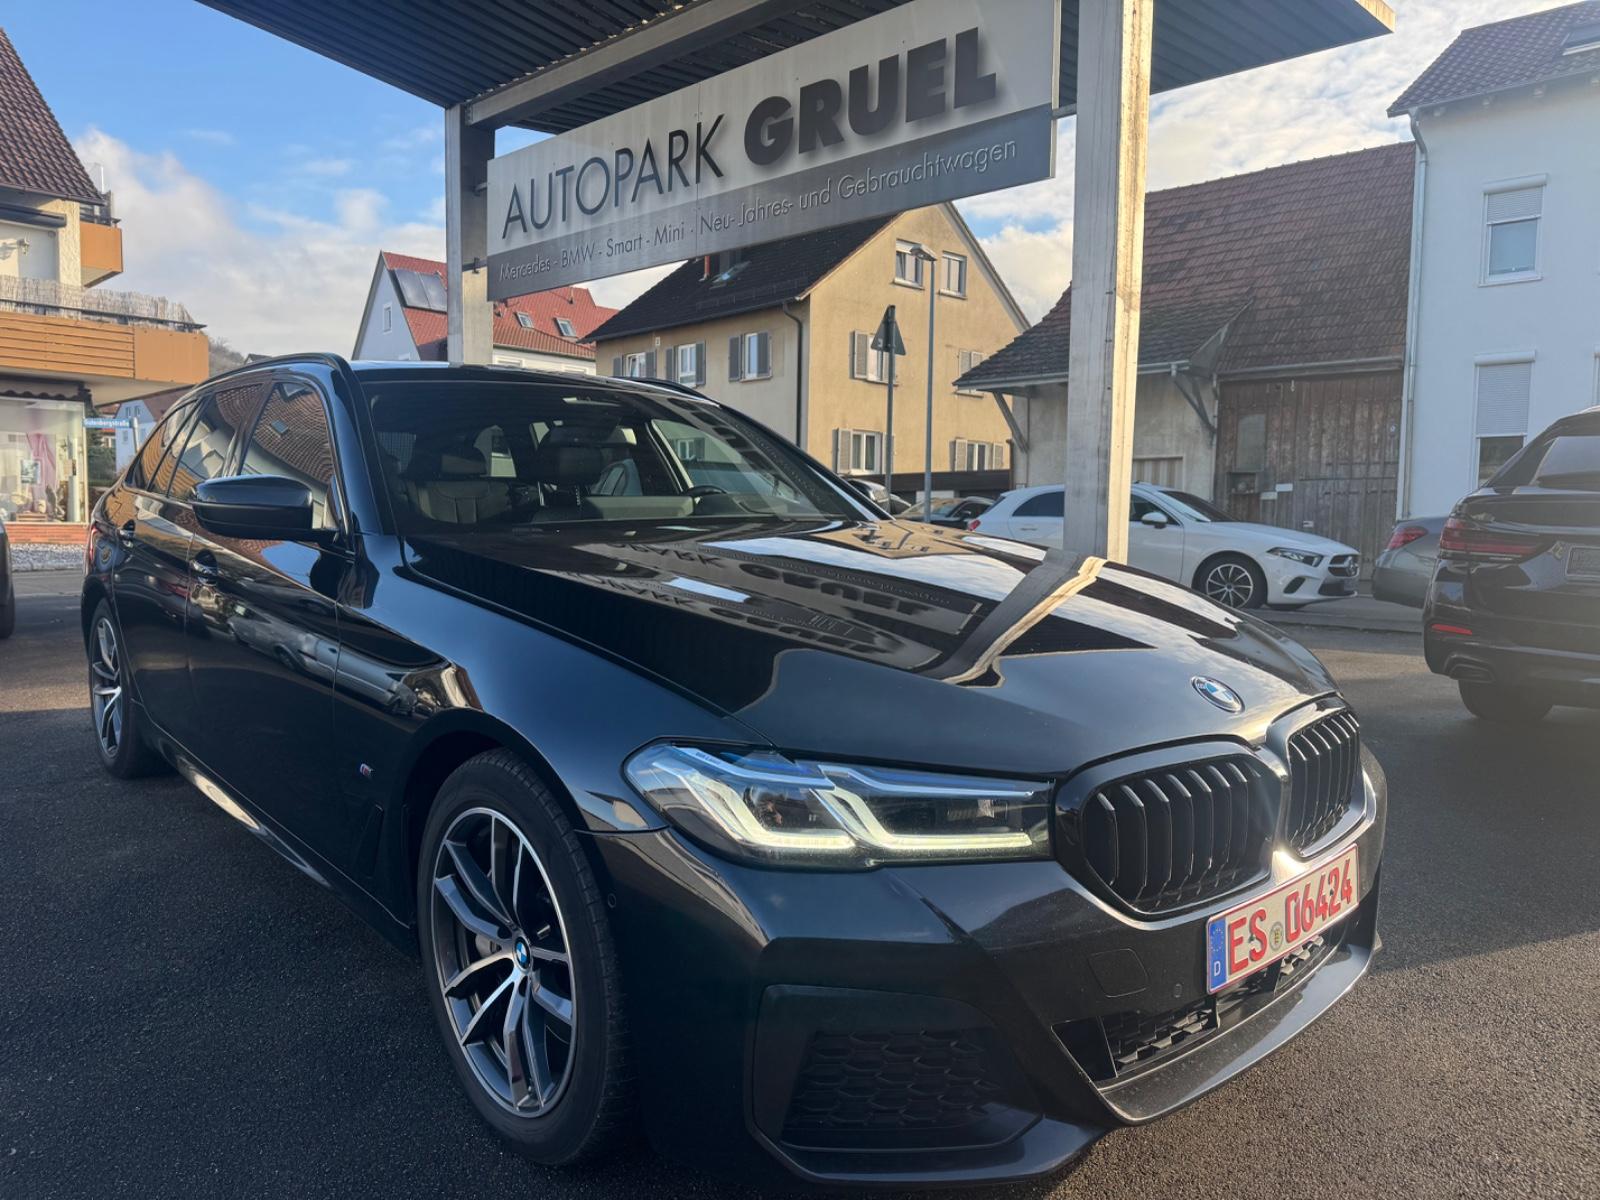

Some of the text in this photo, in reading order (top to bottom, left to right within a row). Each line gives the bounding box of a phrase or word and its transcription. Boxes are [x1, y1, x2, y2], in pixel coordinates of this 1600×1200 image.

[502, 26, 997, 240] AUTOPARK GRUEL
[500, 253, 551, 281] Mercedes
[561, 242, 595, 269] BMW
[606, 233, 642, 257] Smart
[654, 221, 684, 247] Mini
[700, 210, 735, 235] Neu-
[737, 196, 794, 227] Jahres-
[800, 177, 831, 210] und
[837, 139, 1016, 199] Gebrauchtwagen
[1213, 960, 1221, 977] D
[1228, 858, 1353, 975] ES 06424
